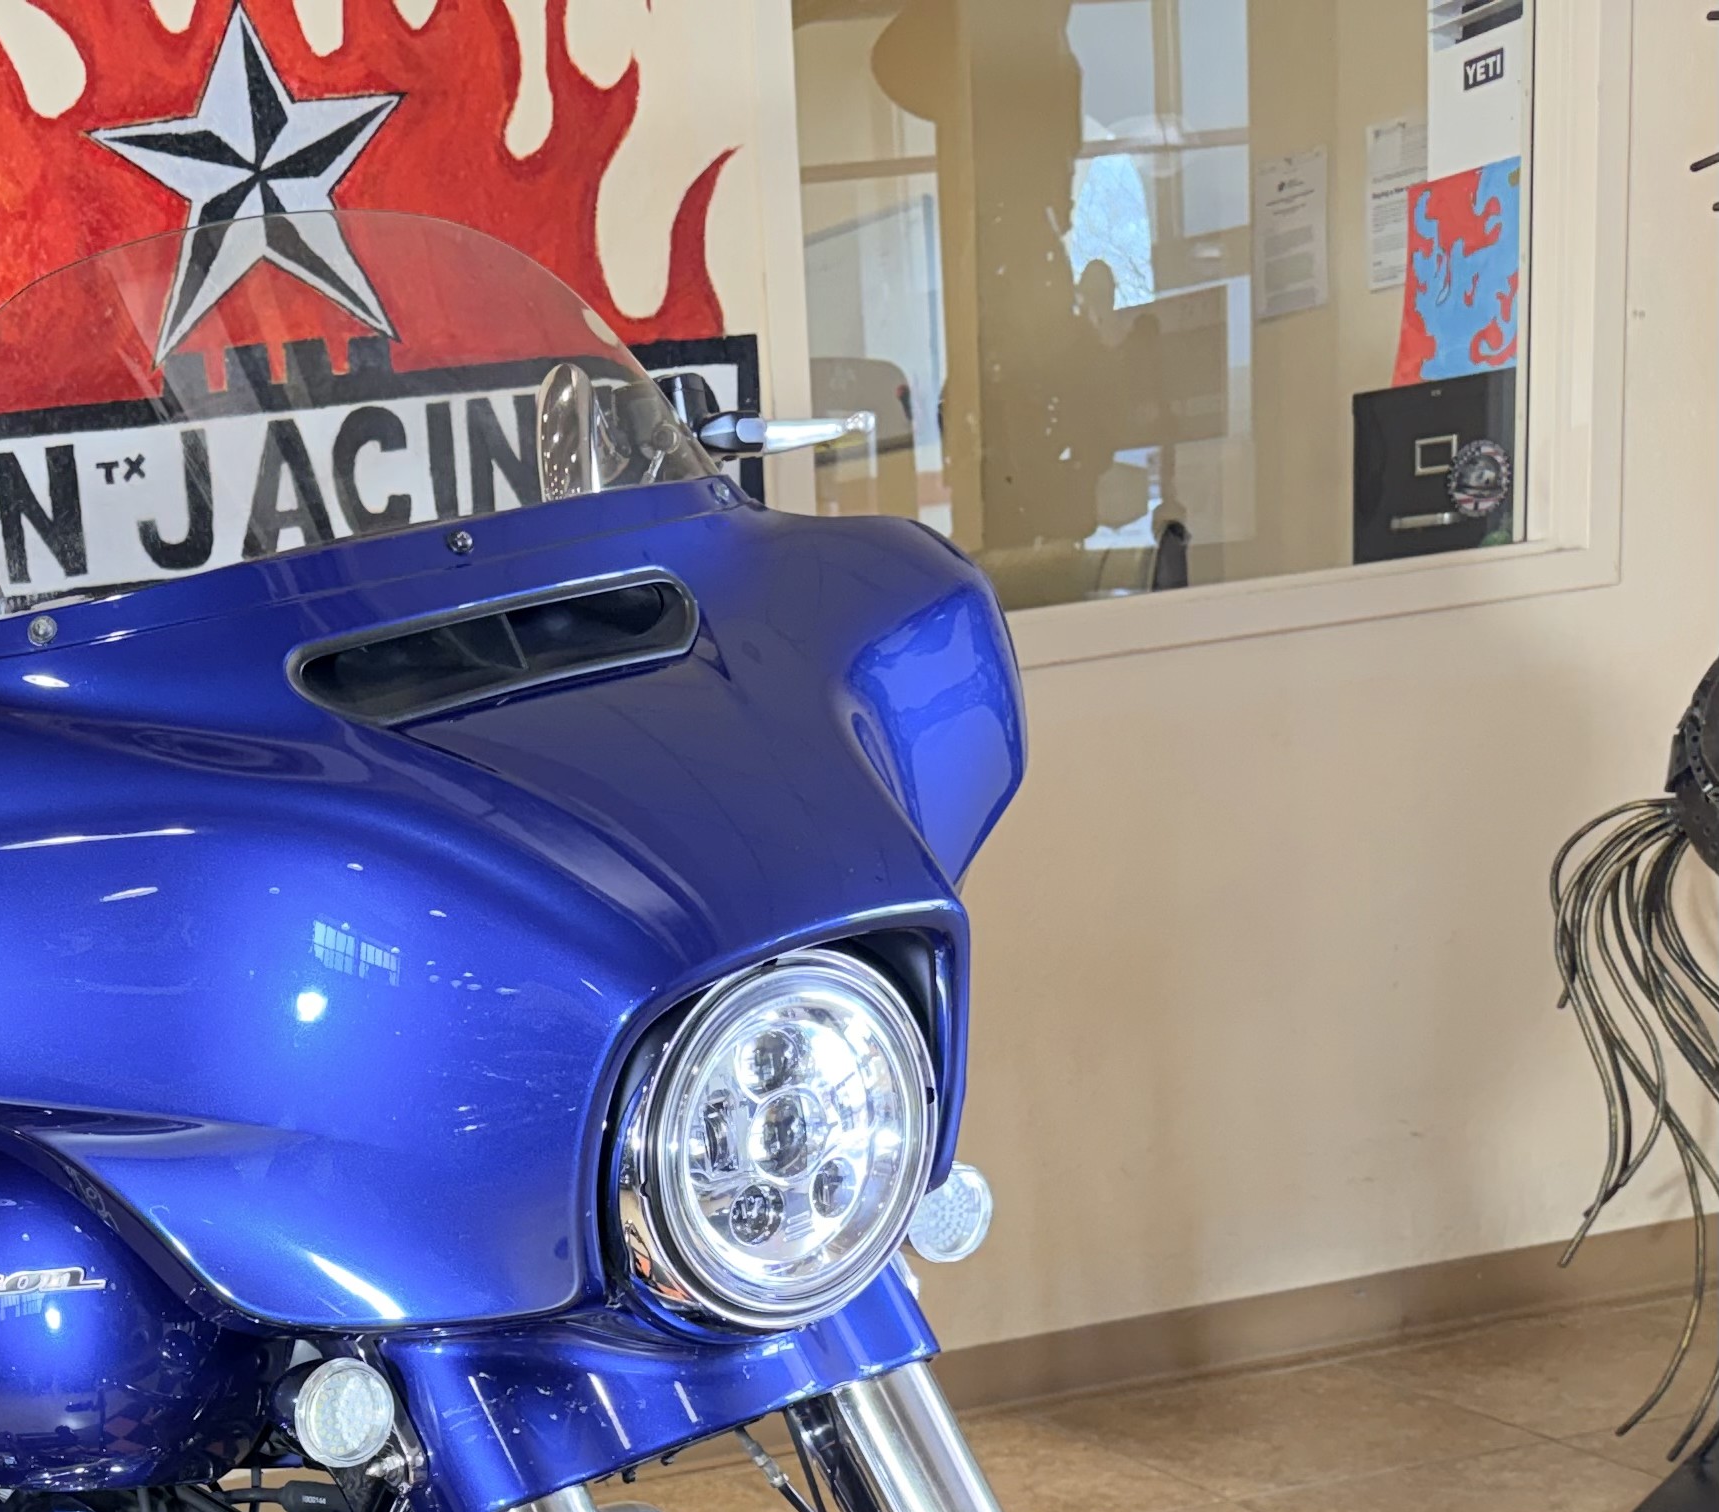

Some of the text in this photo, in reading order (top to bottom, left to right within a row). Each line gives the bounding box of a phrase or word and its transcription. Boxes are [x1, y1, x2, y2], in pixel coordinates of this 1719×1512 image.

[1465, 53, 1502, 85] YETI
[96, 453, 146, 485] TX
[136, 394, 541, 570] JACIN
